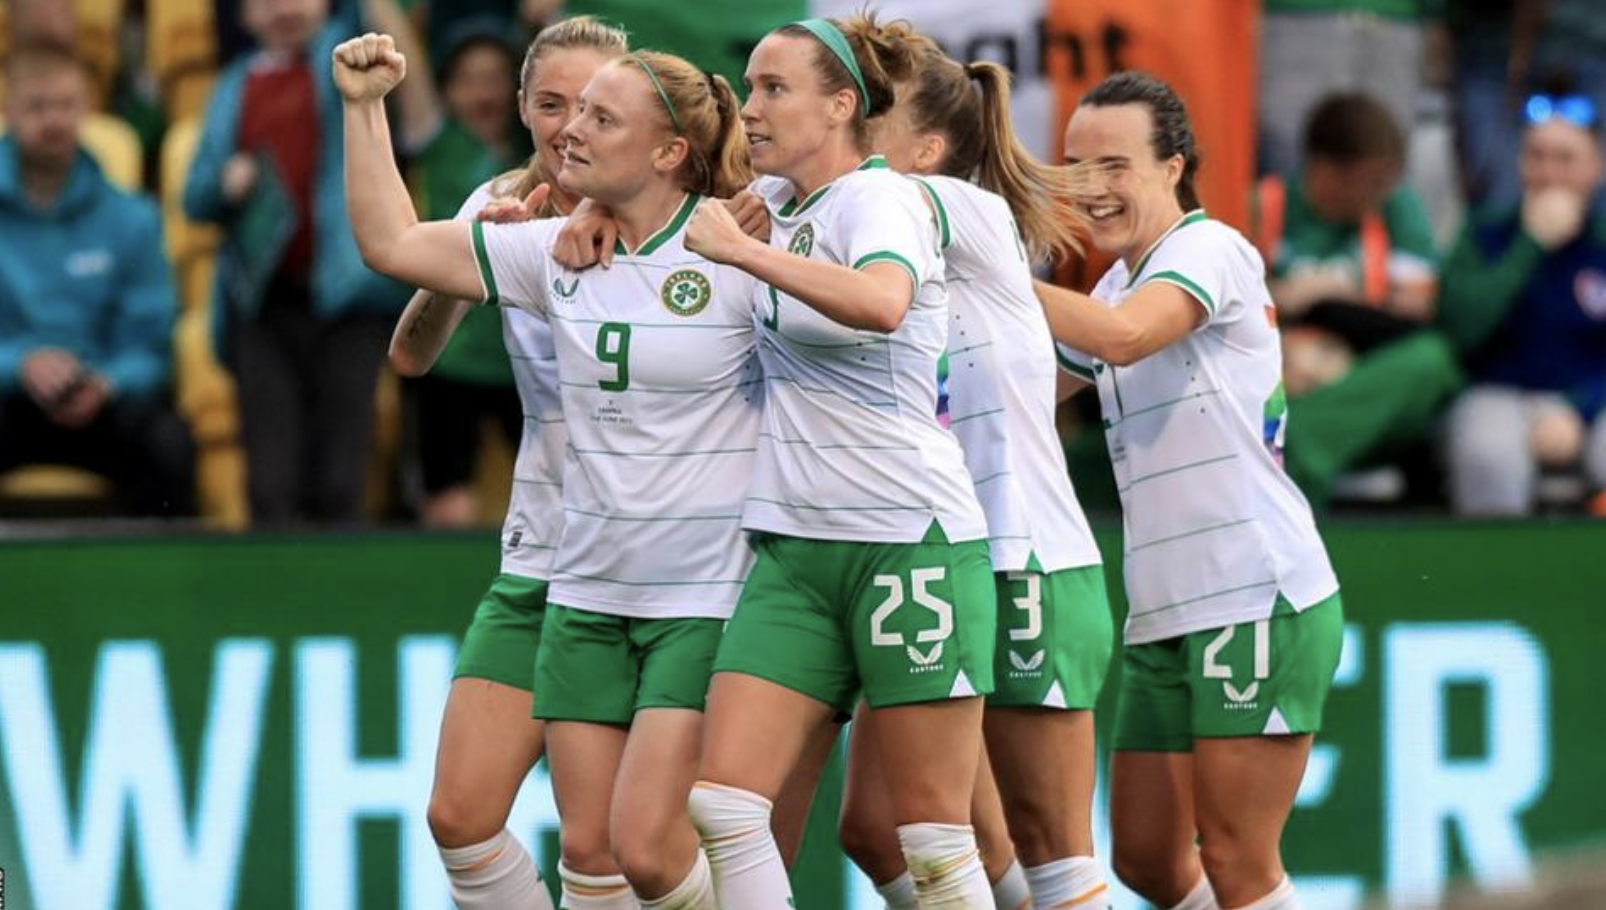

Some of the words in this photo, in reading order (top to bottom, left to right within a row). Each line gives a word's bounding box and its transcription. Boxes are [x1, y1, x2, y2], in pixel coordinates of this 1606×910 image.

[596, 322, 632, 392] 9
[870, 566, 954, 646] 25
[1006, 572, 1042, 641] 3
[1203, 619, 1270, 679] 21
